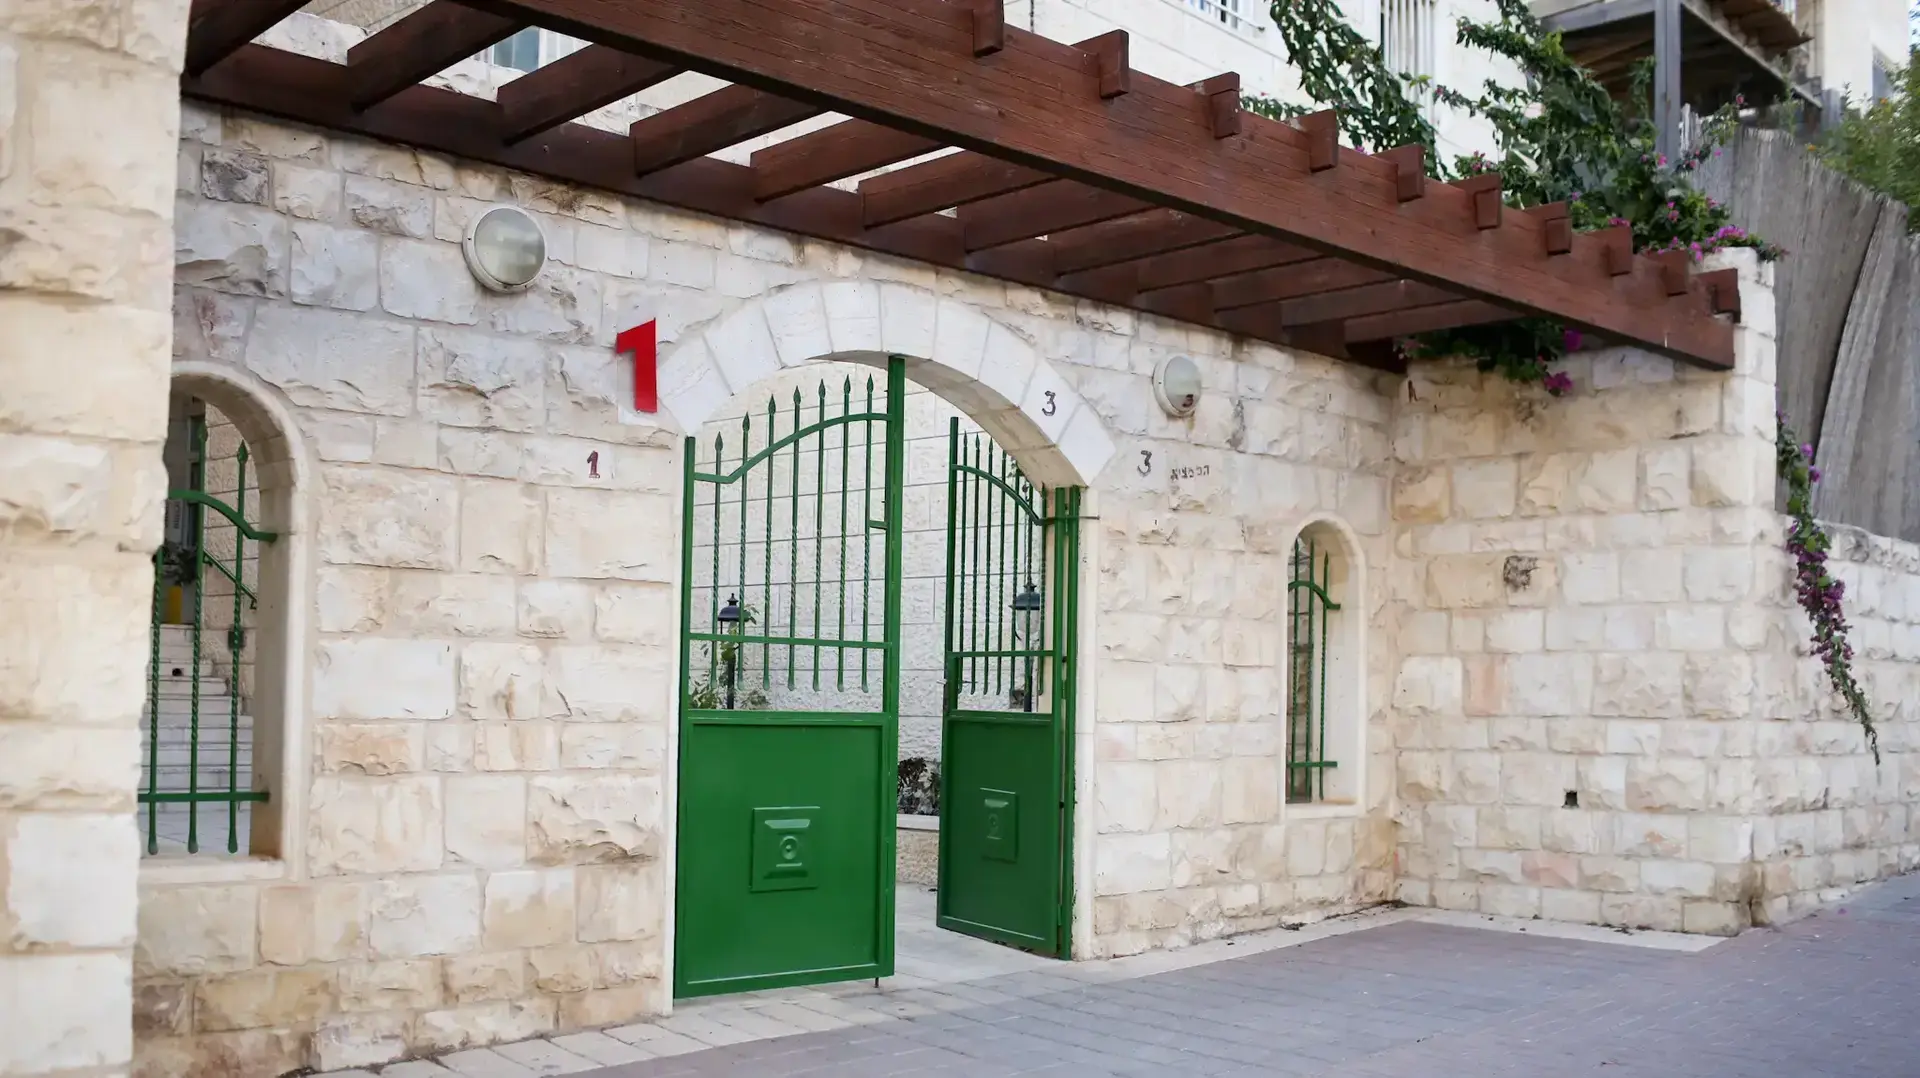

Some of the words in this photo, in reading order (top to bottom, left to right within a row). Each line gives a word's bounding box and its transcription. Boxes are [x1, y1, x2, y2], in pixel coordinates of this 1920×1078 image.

[616, 319, 658, 413] 1
[1041, 390, 1056, 416] 3
[586, 450, 601, 479] 1
[1137, 450, 1153, 476] 3
